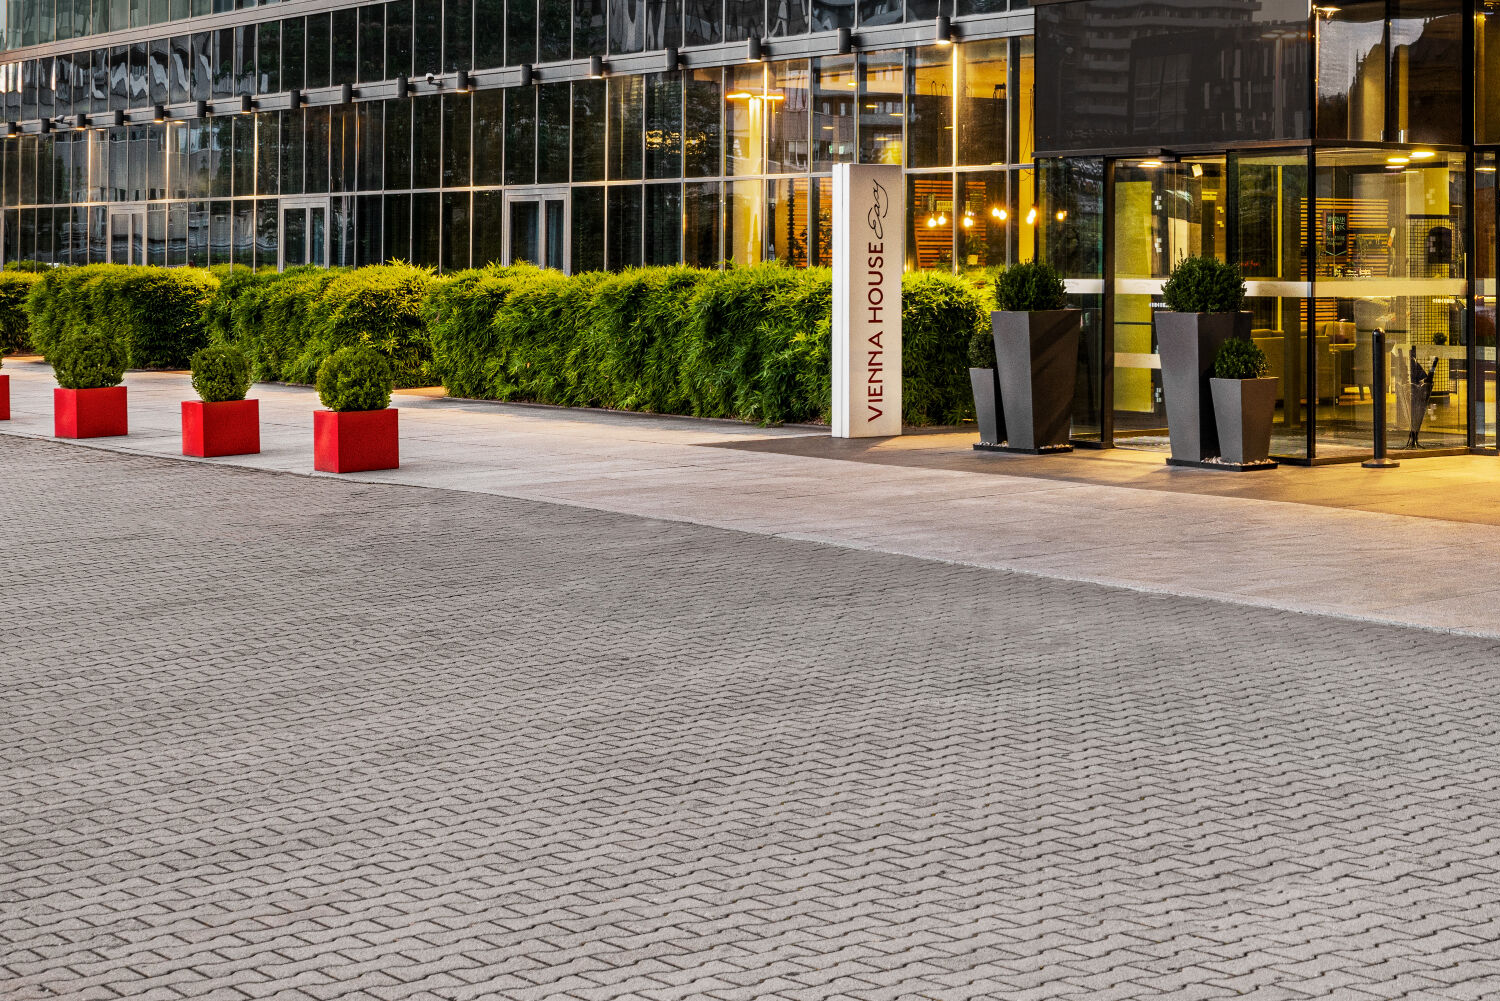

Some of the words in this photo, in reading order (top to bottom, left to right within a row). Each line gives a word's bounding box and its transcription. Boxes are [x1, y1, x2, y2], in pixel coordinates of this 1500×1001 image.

[867, 178, 889, 240] Easy
[867, 242, 884, 324] HOUSE
[867, 330, 884, 423] VIENNA
